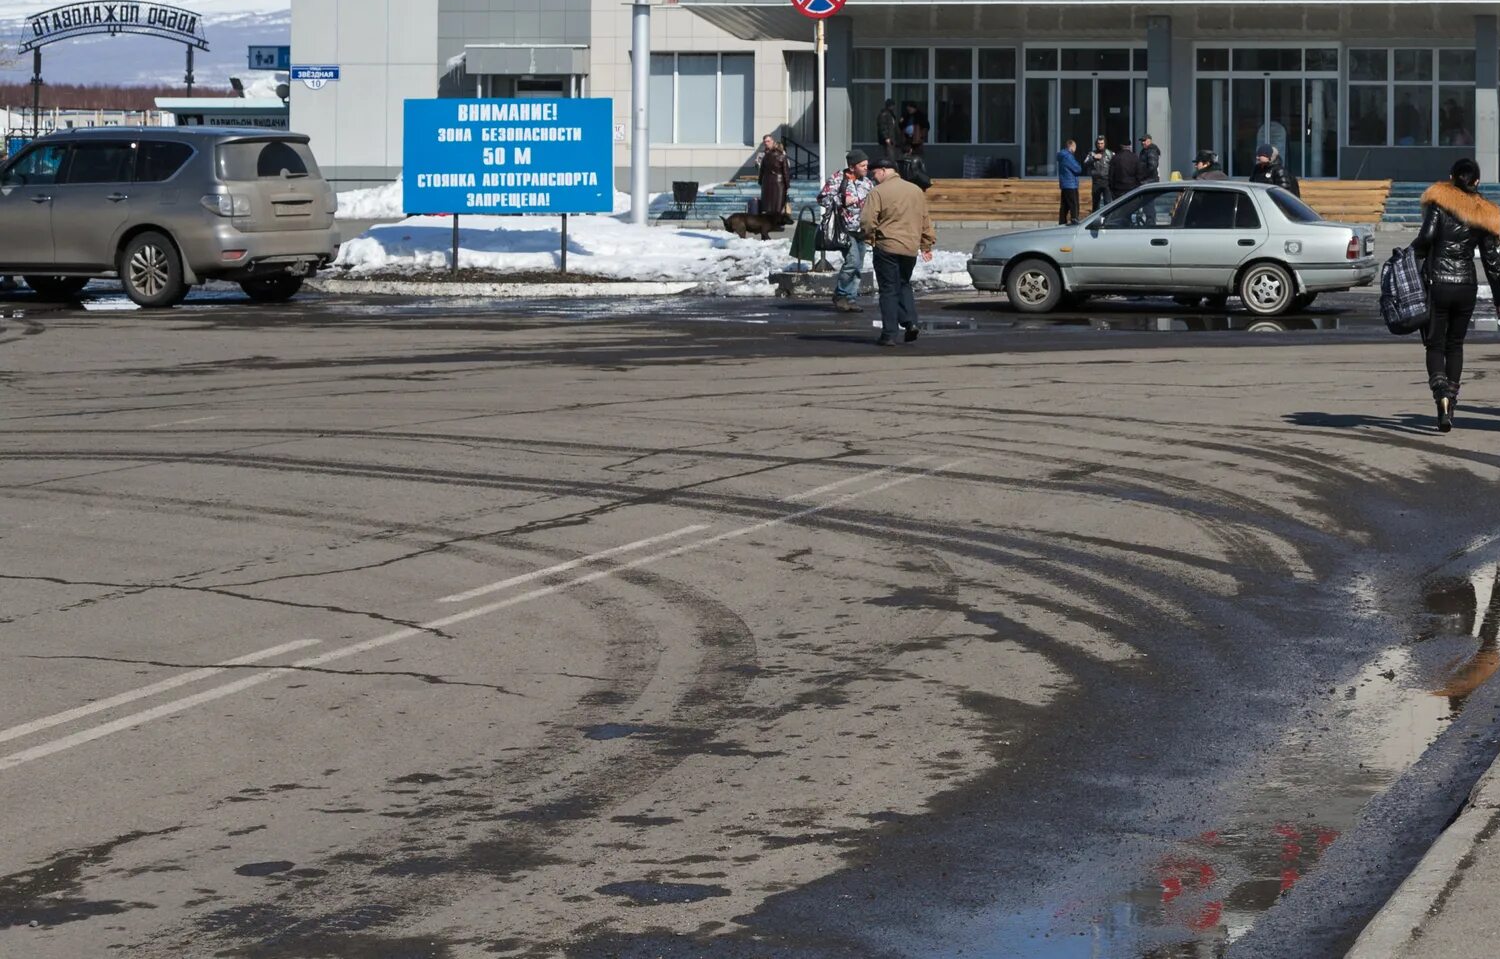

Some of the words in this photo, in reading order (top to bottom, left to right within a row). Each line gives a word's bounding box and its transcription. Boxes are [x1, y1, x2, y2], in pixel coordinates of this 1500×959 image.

[297, 71, 335, 79] ЗВЁЗДНАЯ
[311, 80, 322, 88] 10
[457, 103, 558, 122] ВНИМАНИЕ!
[437, 128, 472, 142] ЗОНА
[481, 127, 582, 141] БЕЗОПАСНОСТИ
[482, 147, 506, 165] 50
[514, 147, 532, 165] М
[417, 173, 476, 188] СТОЯНКА
[482, 172, 597, 187] АВТОТРАНСПОРТА
[466, 193, 551, 207] ЗАПРЕЩЕНА!
